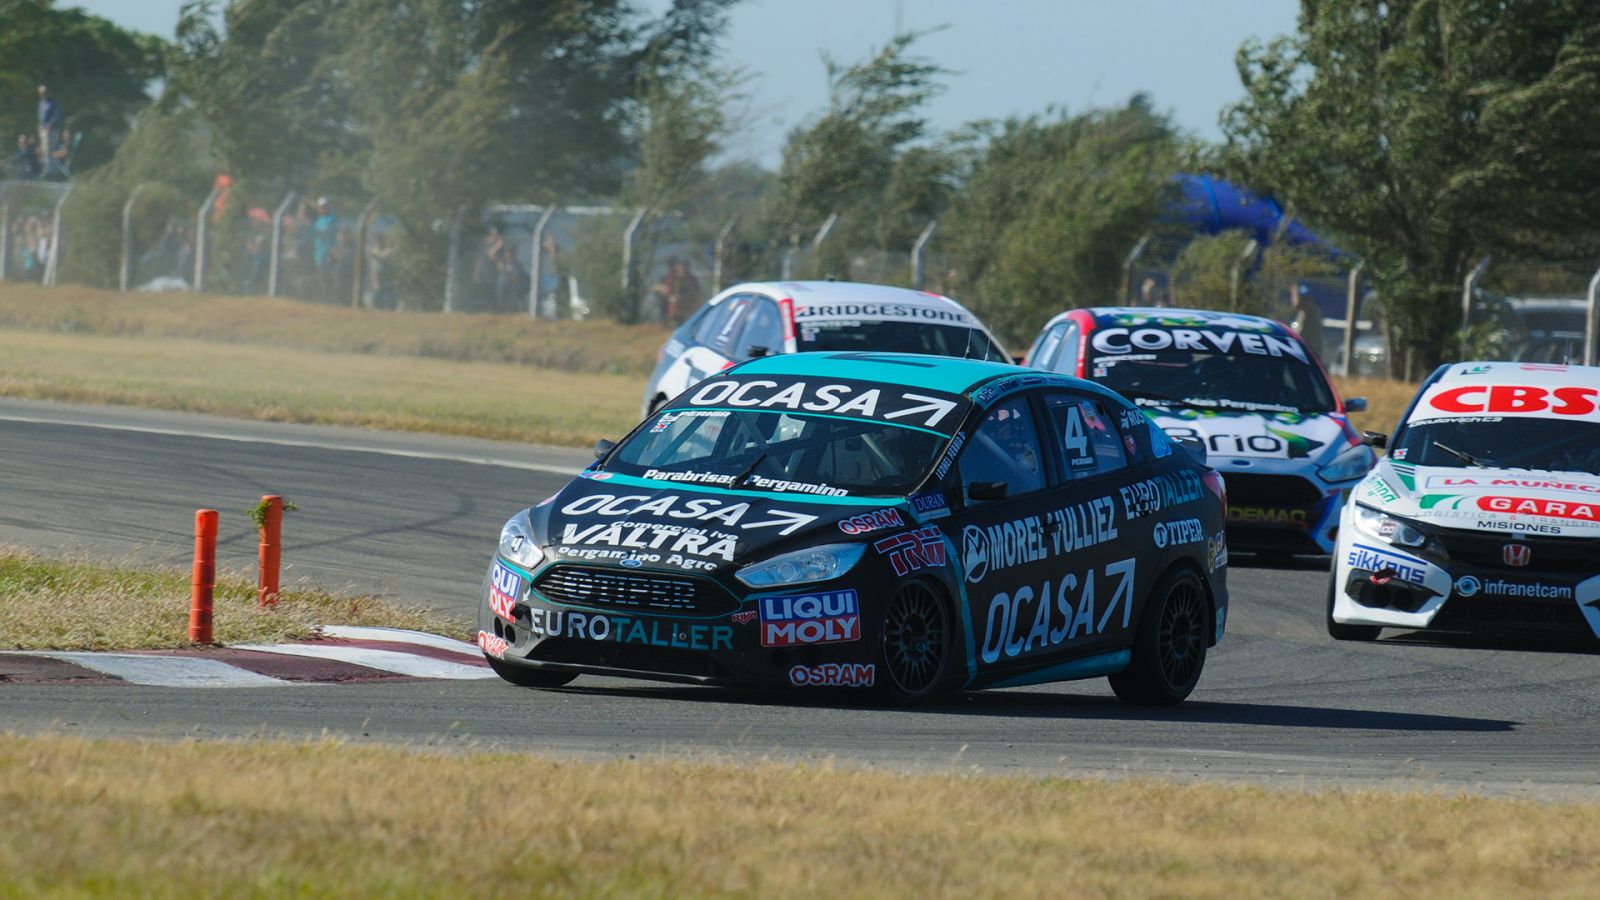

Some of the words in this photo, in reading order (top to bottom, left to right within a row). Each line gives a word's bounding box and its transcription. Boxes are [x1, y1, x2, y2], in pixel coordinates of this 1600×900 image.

[796, 303, 970, 324] BRIDGESTONE
[1092, 327, 1310, 365] CORVEN
[690, 380, 881, 417] OCASA
[1430, 385, 1600, 416] CBS
[1065, 406, 1088, 457] 4
[743, 475, 848, 498] Pergamino
[562, 494, 751, 526] OCASA
[837, 508, 906, 535] OSRAM
[610, 521, 709, 536] Comercial
[1167, 518, 1205, 545] TIPER
[1477, 520, 1561, 534] MISIONES
[510, 535, 523, 552] 4
[558, 547, 661, 562] Pergamino
[562, 523, 739, 562] VALTRA
[873, 526, 946, 576] TRW
[988, 515, 1048, 571] MOREL
[1348, 550, 1426, 585] sikkens
[489, 587, 515, 620] OLY
[1484, 579, 1572, 598] infranetcam
[764, 592, 854, 621] LIQUI
[981, 564, 1094, 664] OCASA
[530, 608, 735, 650] EUROTALLER
[767, 617, 857, 645] MOLY
[790, 663, 876, 687] OSRAM
